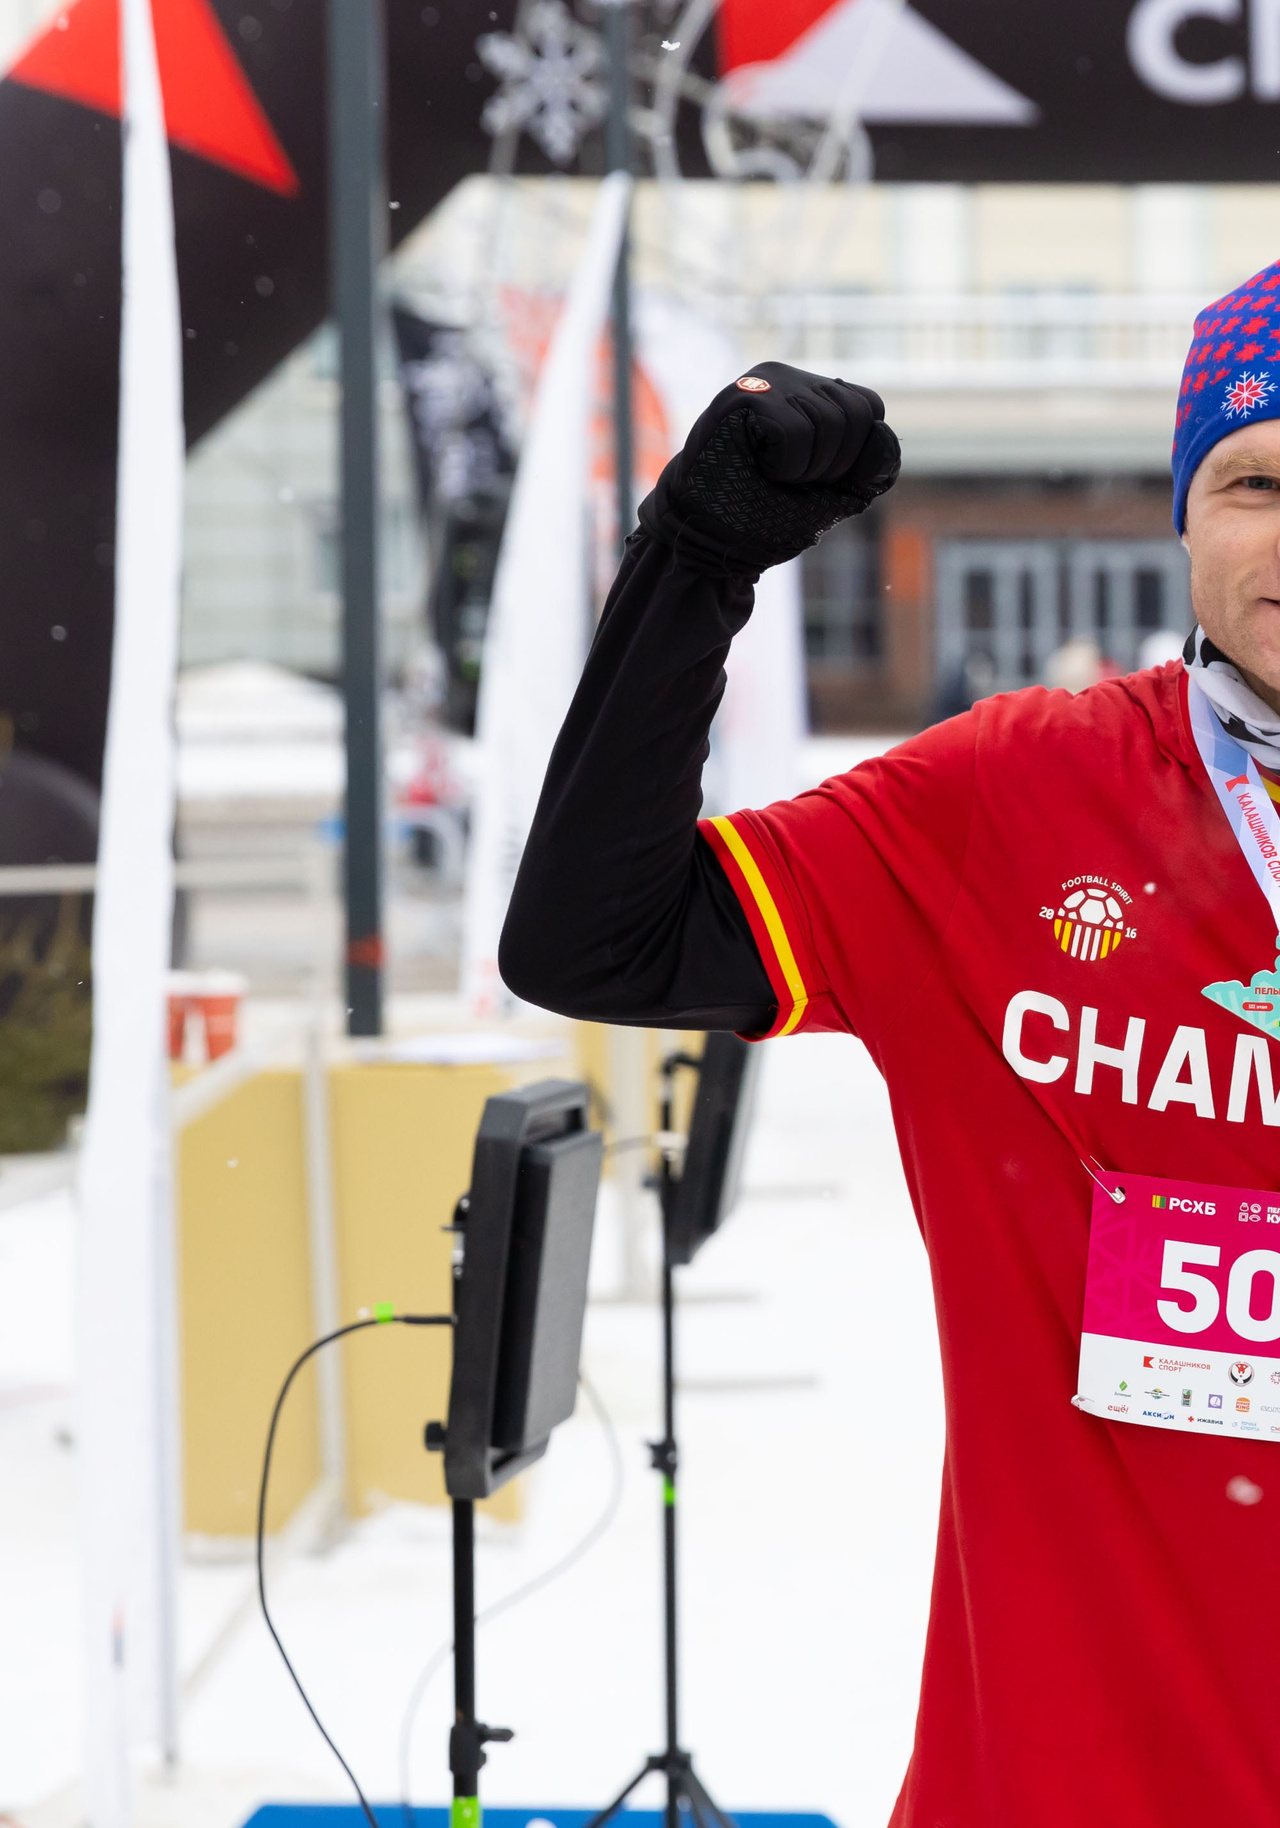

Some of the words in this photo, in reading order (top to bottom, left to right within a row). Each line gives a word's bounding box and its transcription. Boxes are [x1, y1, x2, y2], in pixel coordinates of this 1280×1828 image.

[1236, 792, 1278, 859] КАЛАШНИКОВ
[1061, 875, 1109, 891] FOOTBALL
[1110, 882, 1134, 905] SPIRIT
[1124, 927, 1137, 939] 16
[1168, 1197, 1217, 1216] РСХБ
[1158, 1358, 1211, 1370] КАЛАШНИКОВ
[1158, 1365, 1182, 1373] СПОРТ
[1142, 1410, 1175, 1420] АКСИОН
